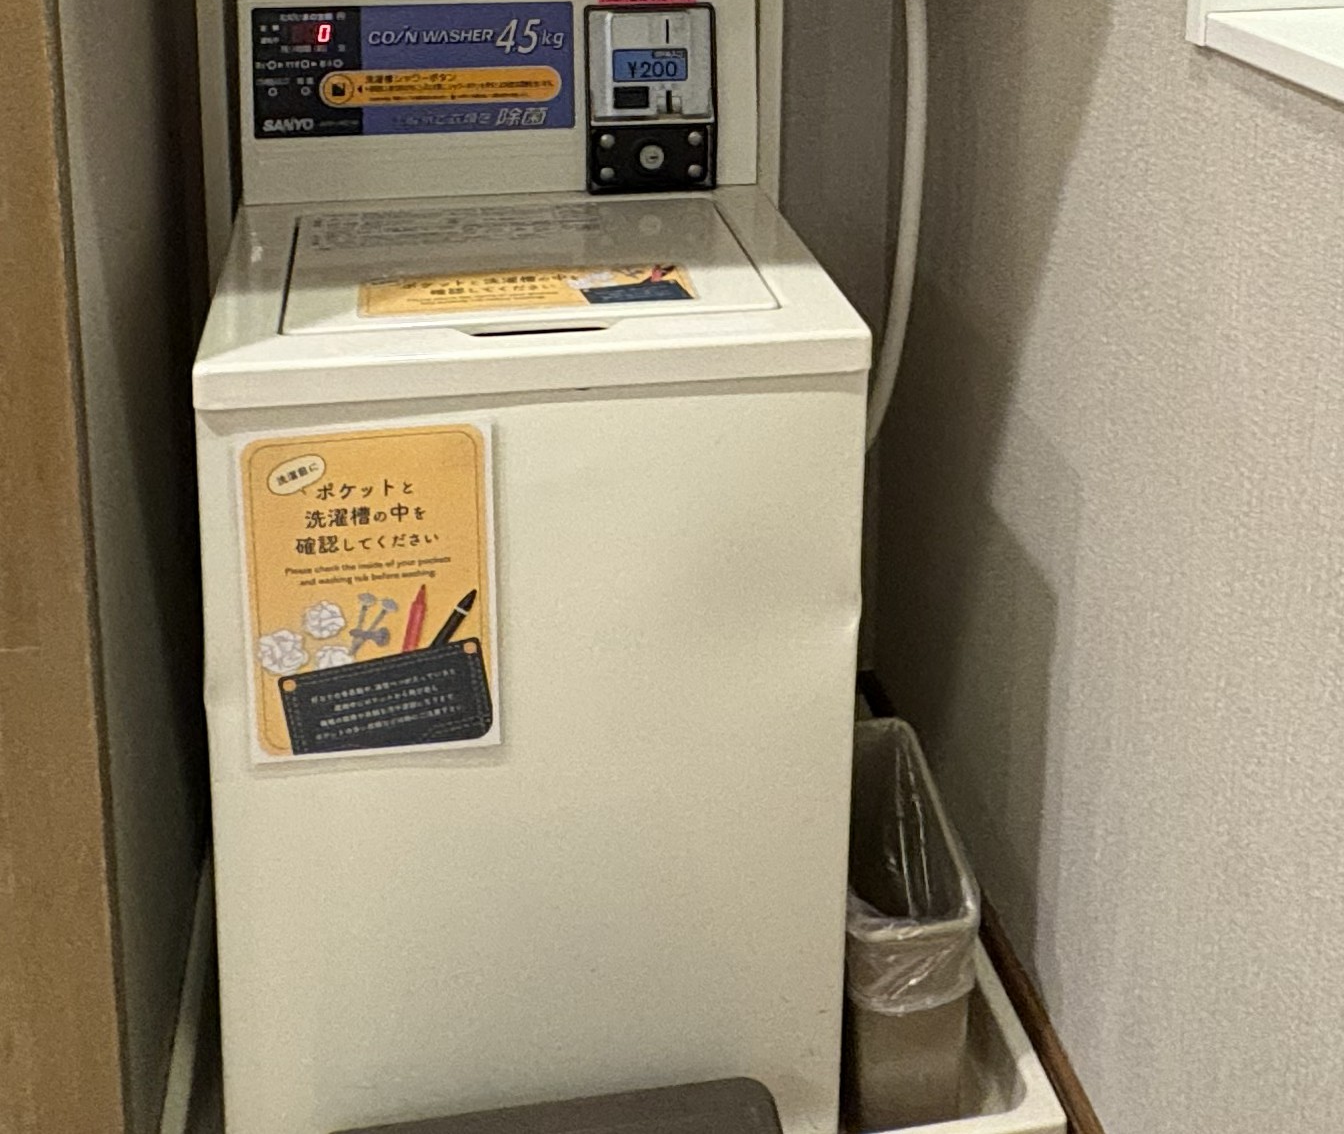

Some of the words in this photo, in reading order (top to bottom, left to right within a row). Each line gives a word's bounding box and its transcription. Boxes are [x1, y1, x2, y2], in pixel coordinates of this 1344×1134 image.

[317, 24, 332, 43] 0
[422, 29, 494, 44] WASHER
[627, 61, 678, 78] ¥200
[263, 118, 314, 133] SANYO
[495, 107, 548, 126] 除菌
[315, 478, 414, 501] ポケットと
[305, 503, 426, 529] 洗濯槽の中を
[295, 533, 439, 555] 確認してください
